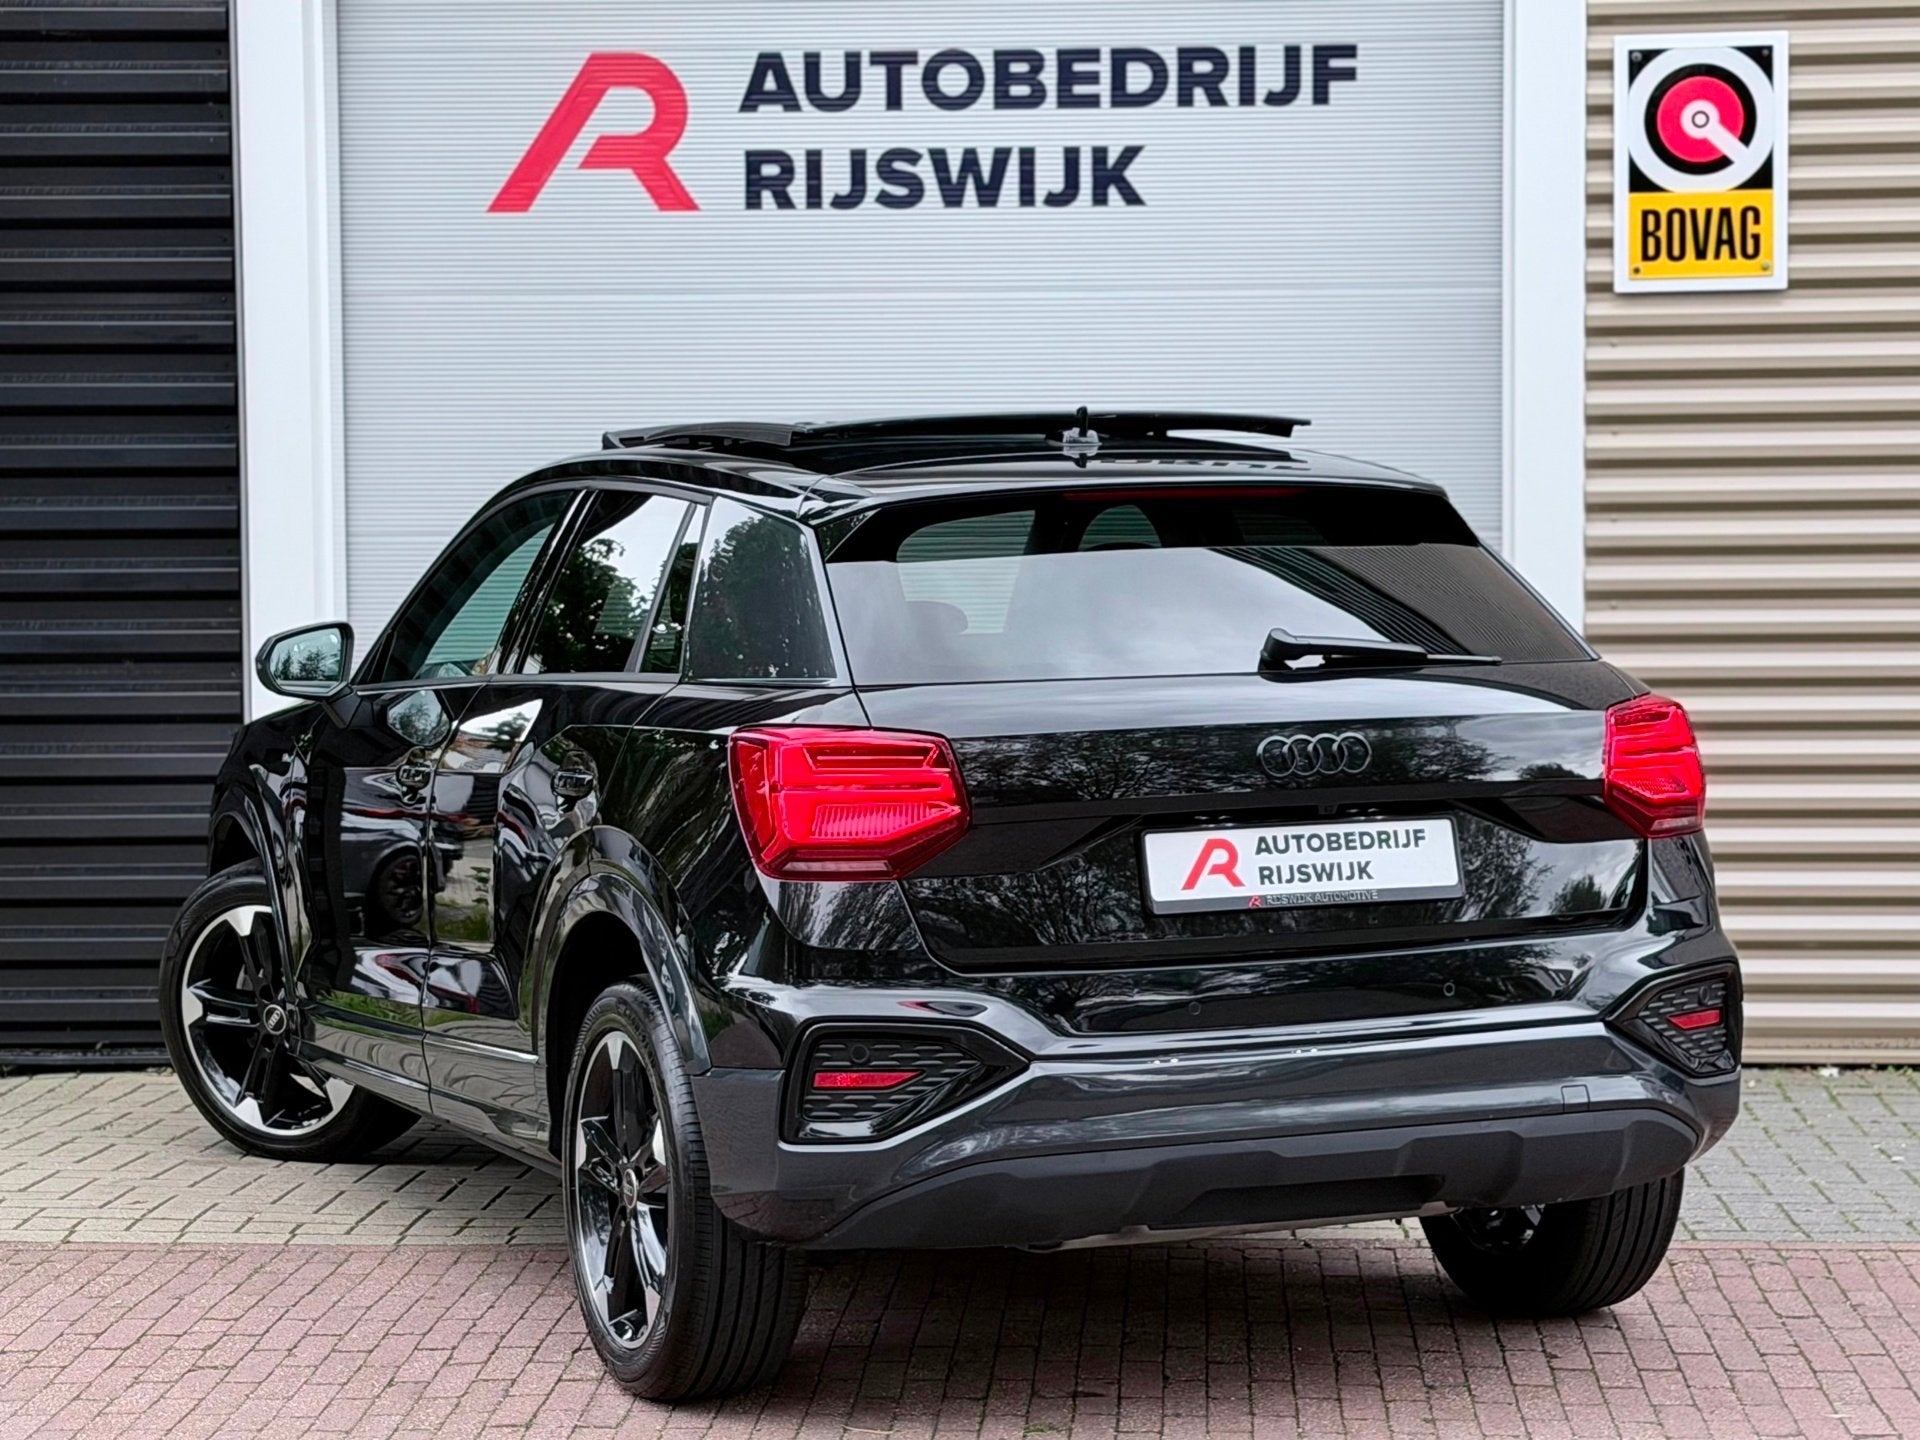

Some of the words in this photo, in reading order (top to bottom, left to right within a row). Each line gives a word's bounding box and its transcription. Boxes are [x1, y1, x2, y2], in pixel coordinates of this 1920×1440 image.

[739, 43, 1358, 113] AUTOBEDRIJF
[744, 144, 1146, 211] RIJSWIJK
[1641, 206, 1761, 263] BOVAG
[1255, 828, 1426, 856] AUTOBEDRIJF
[1259, 860, 1375, 886] RIJSWIJK
[1315, 889, 1379, 904] AUTOMOTIVE
